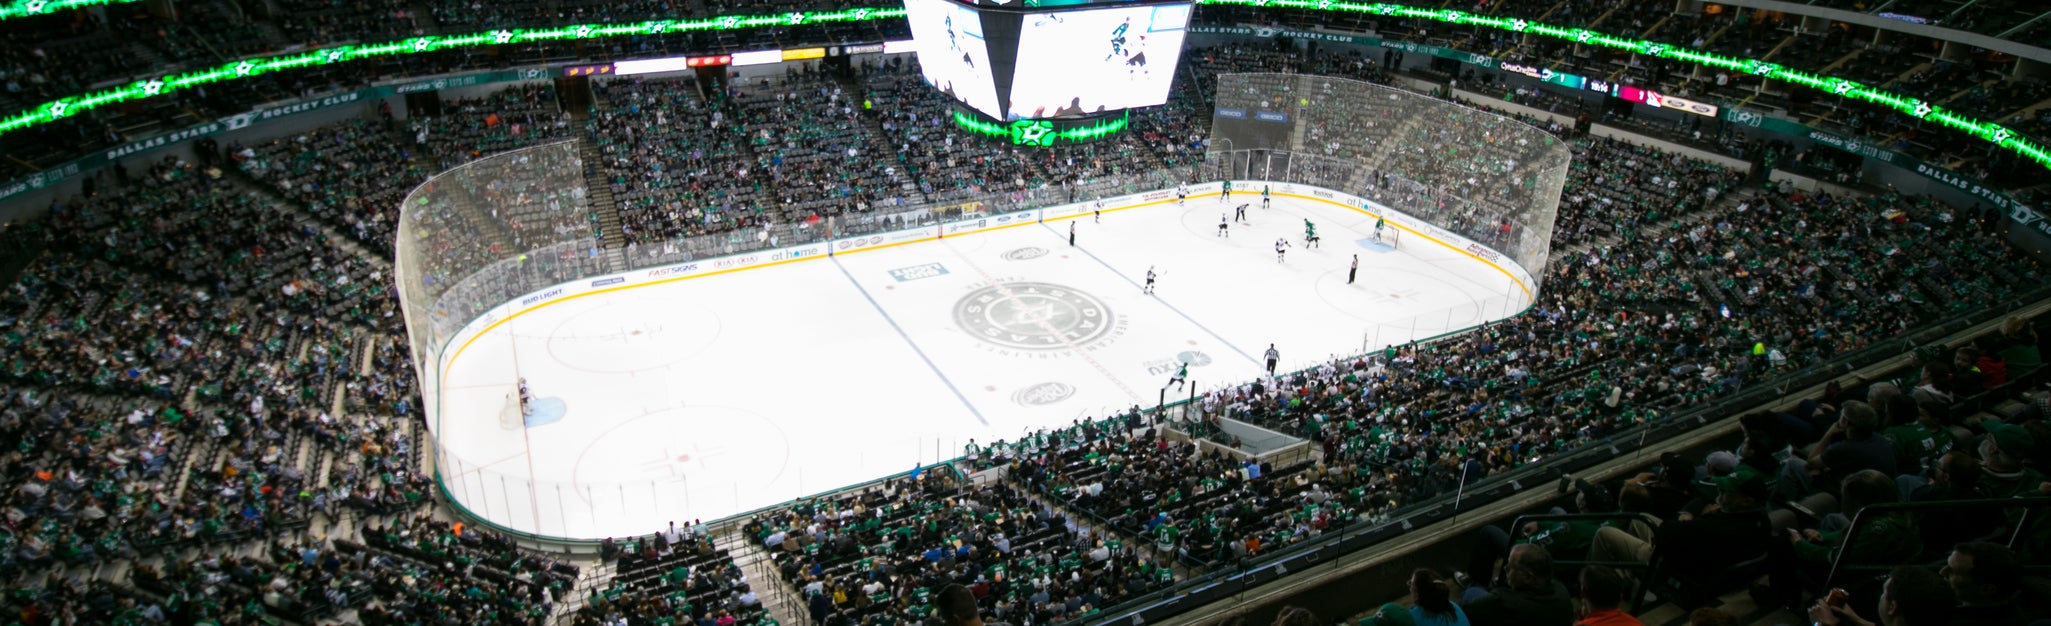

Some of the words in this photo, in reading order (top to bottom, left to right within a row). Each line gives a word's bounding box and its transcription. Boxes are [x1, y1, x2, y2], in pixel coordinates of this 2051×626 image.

[1283, 31, 1323, 40] HOCKEY
[1326, 35, 1353, 43] CLUB
[262, 100, 320, 119] HOCKEY
[323, 92, 358, 106] CLUB
[1220, 110, 1242, 119] GEICO
[1260, 112, 1284, 122] GEICO
[107, 136, 166, 160] DALLAS
[169, 123, 218, 142] STARS
[1917, 164, 1968, 190] DALLAS
[1970, 184, 2009, 209] STARS
[771, 252, 785, 262] at
[522, 295, 539, 306] BUD
[540, 288, 563, 302] LIGHT
